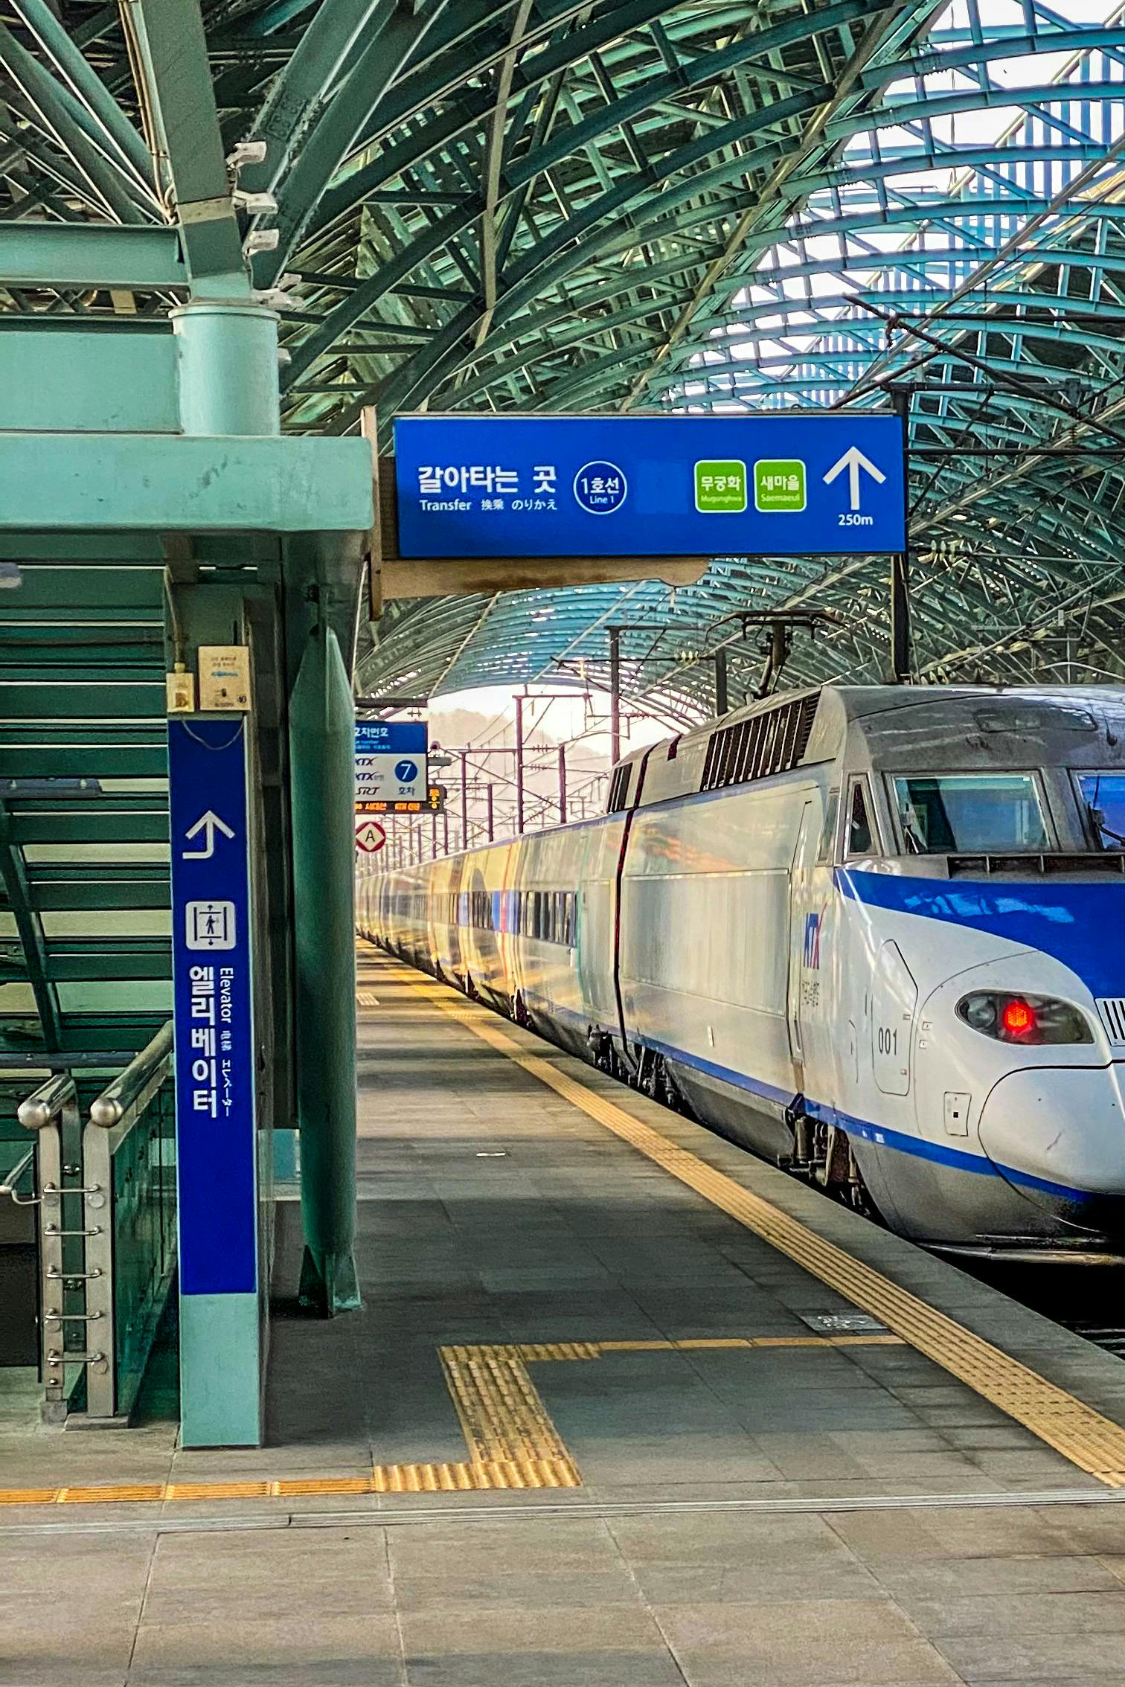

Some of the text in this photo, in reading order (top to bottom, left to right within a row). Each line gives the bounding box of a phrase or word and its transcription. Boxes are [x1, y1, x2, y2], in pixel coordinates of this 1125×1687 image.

[418, 465, 557, 493] 갈아타는 곳
[580, 477, 620, 494] 1호선
[701, 476, 741, 492] 무궁화
[760, 475, 800, 491] 새마을
[419, 499, 472, 511] Transfer
[511, 499, 558, 511] のりかえ
[589, 495, 615, 504] Line 1
[838, 514, 874, 526] 250m
[400, 763, 412, 780] 7
[355, 786, 380, 796] SRT
[398, 786, 416, 797] 호차
[364, 829, 376, 842] A
[220, 967, 234, 1024] Elevator
[189, 965, 217, 1118] 엘리베이터
[878, 1027, 898, 1056] 001
[221, 1059, 233, 1117] エレベーター
